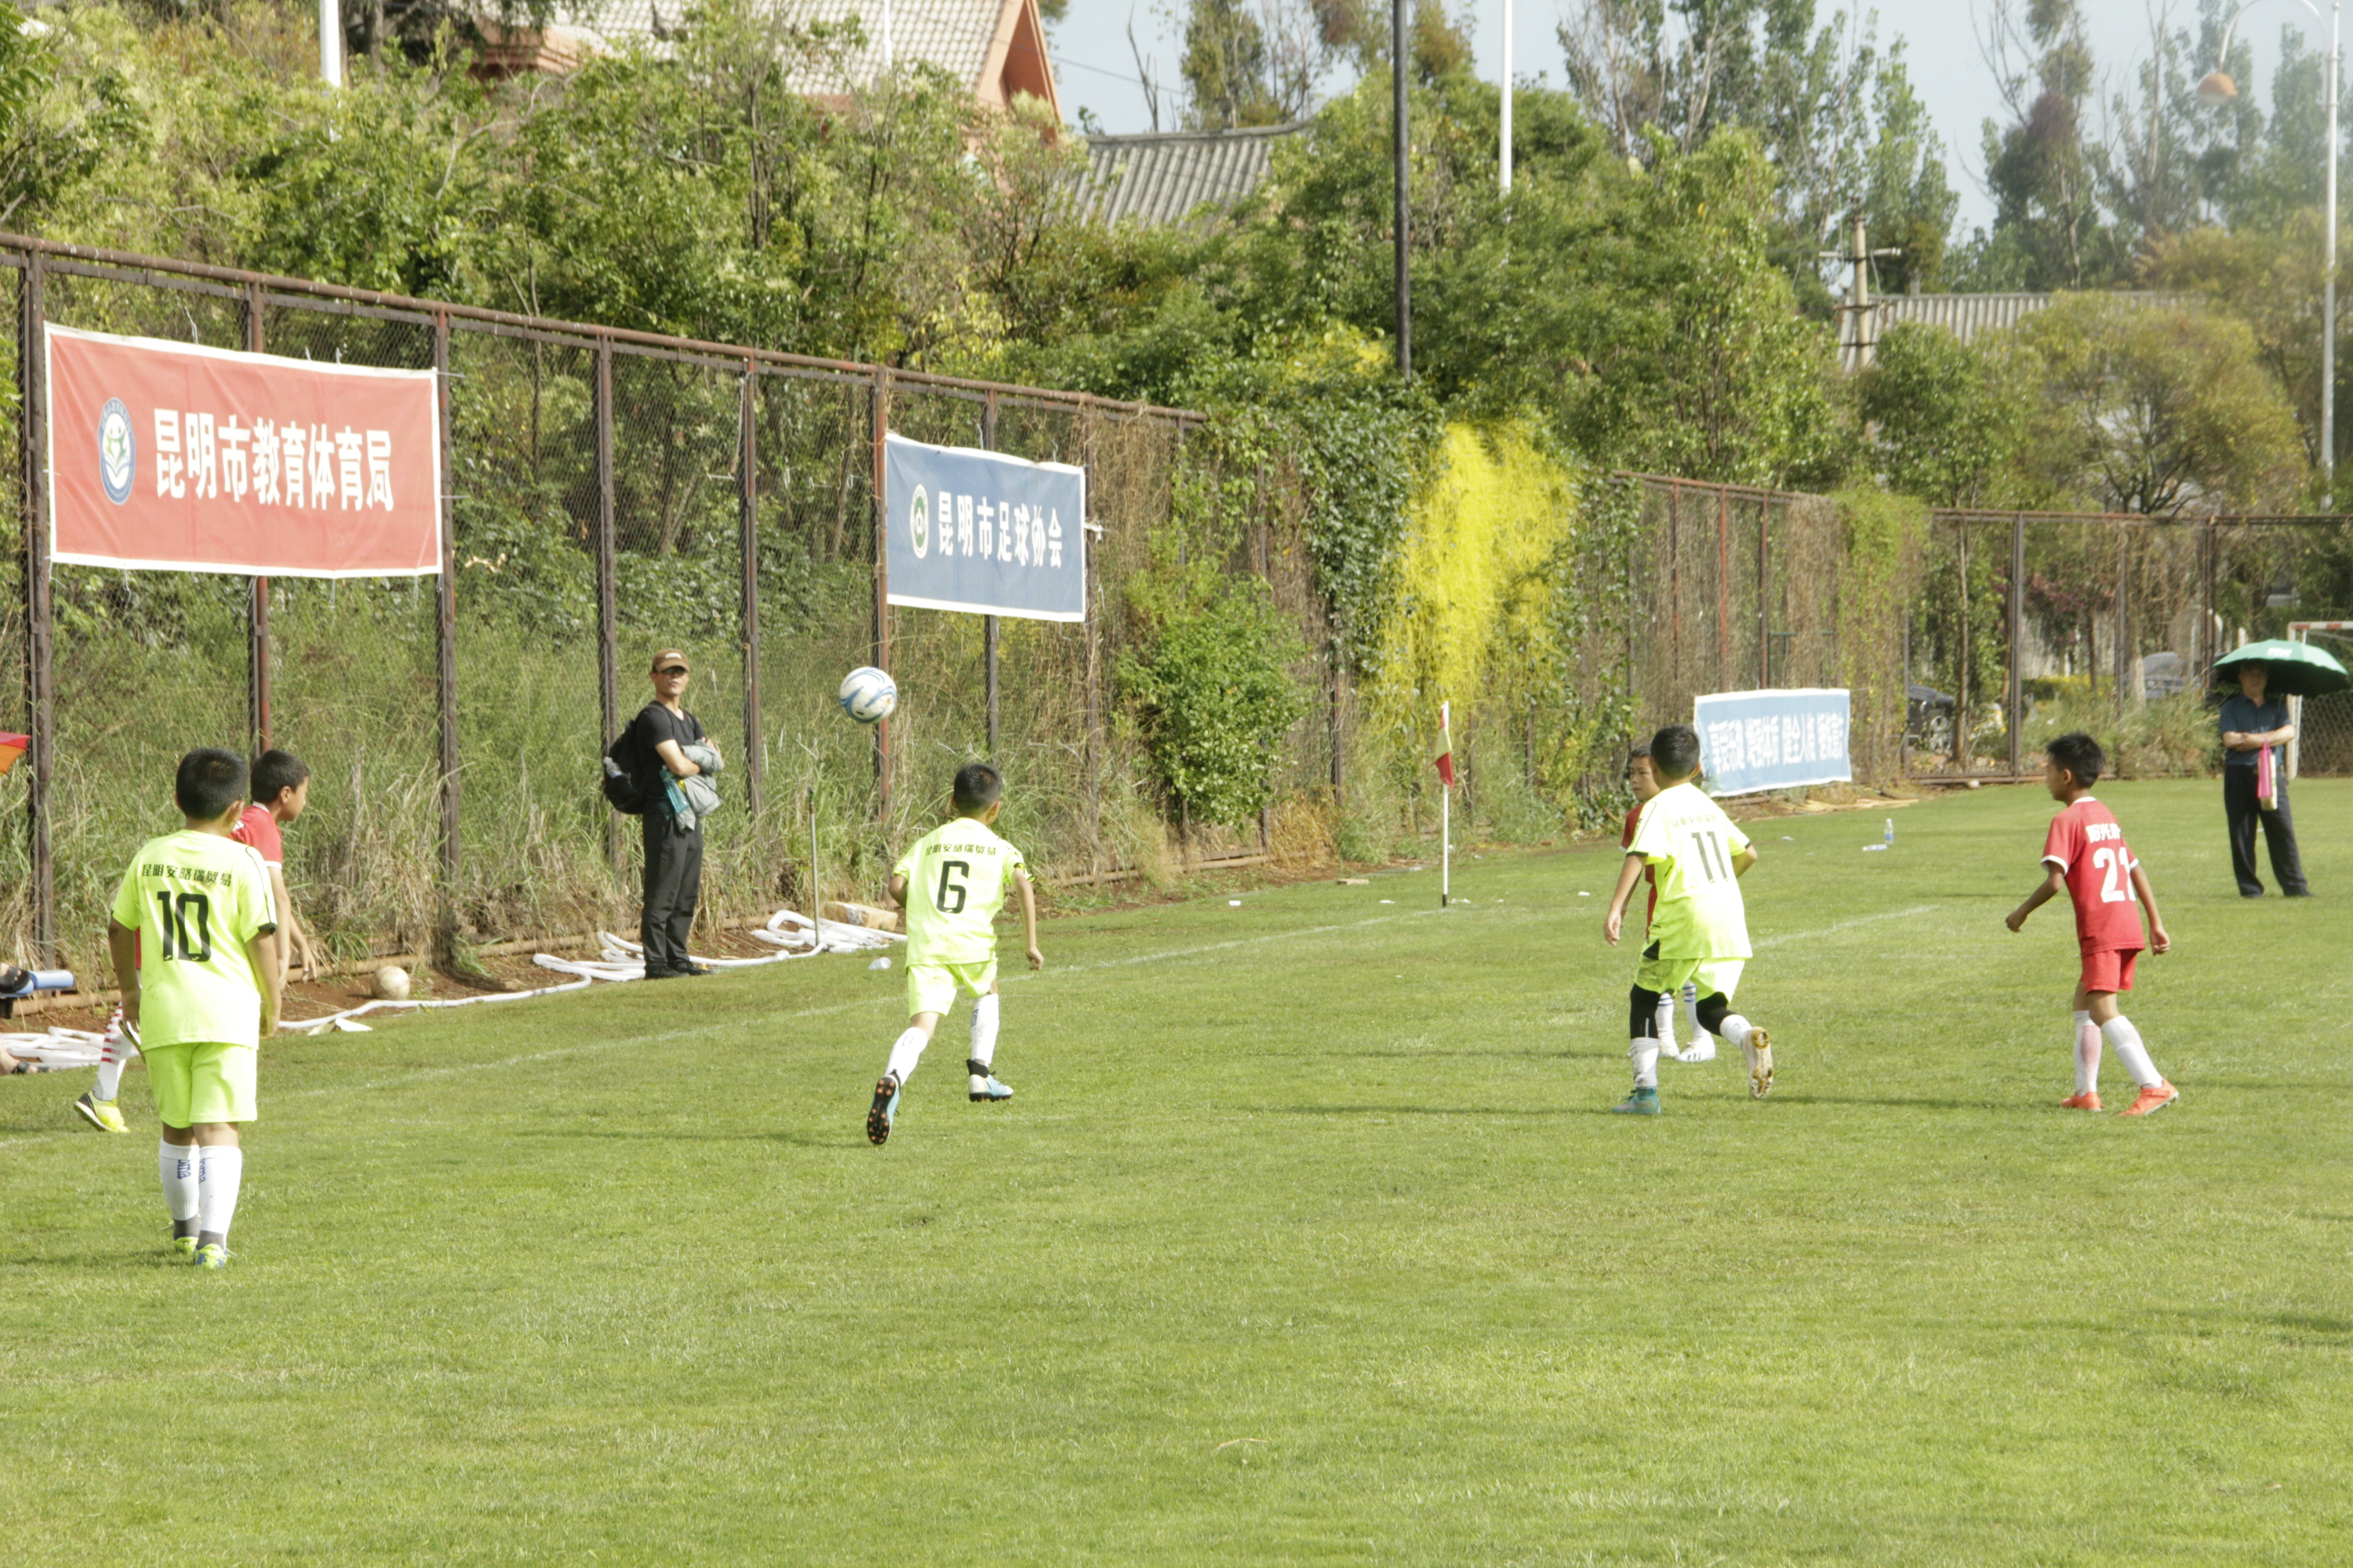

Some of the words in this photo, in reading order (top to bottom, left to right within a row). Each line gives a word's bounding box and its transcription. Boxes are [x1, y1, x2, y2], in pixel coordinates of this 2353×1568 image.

[154, 408, 393, 512] 昆明市教育体育局
[938, 491, 1063, 569] 昆明市足球协会
[936, 860, 970, 914] 6
[1691, 831, 1729, 883] 11
[2093, 847, 2136, 903] 21
[157, 890, 212, 962] 10
